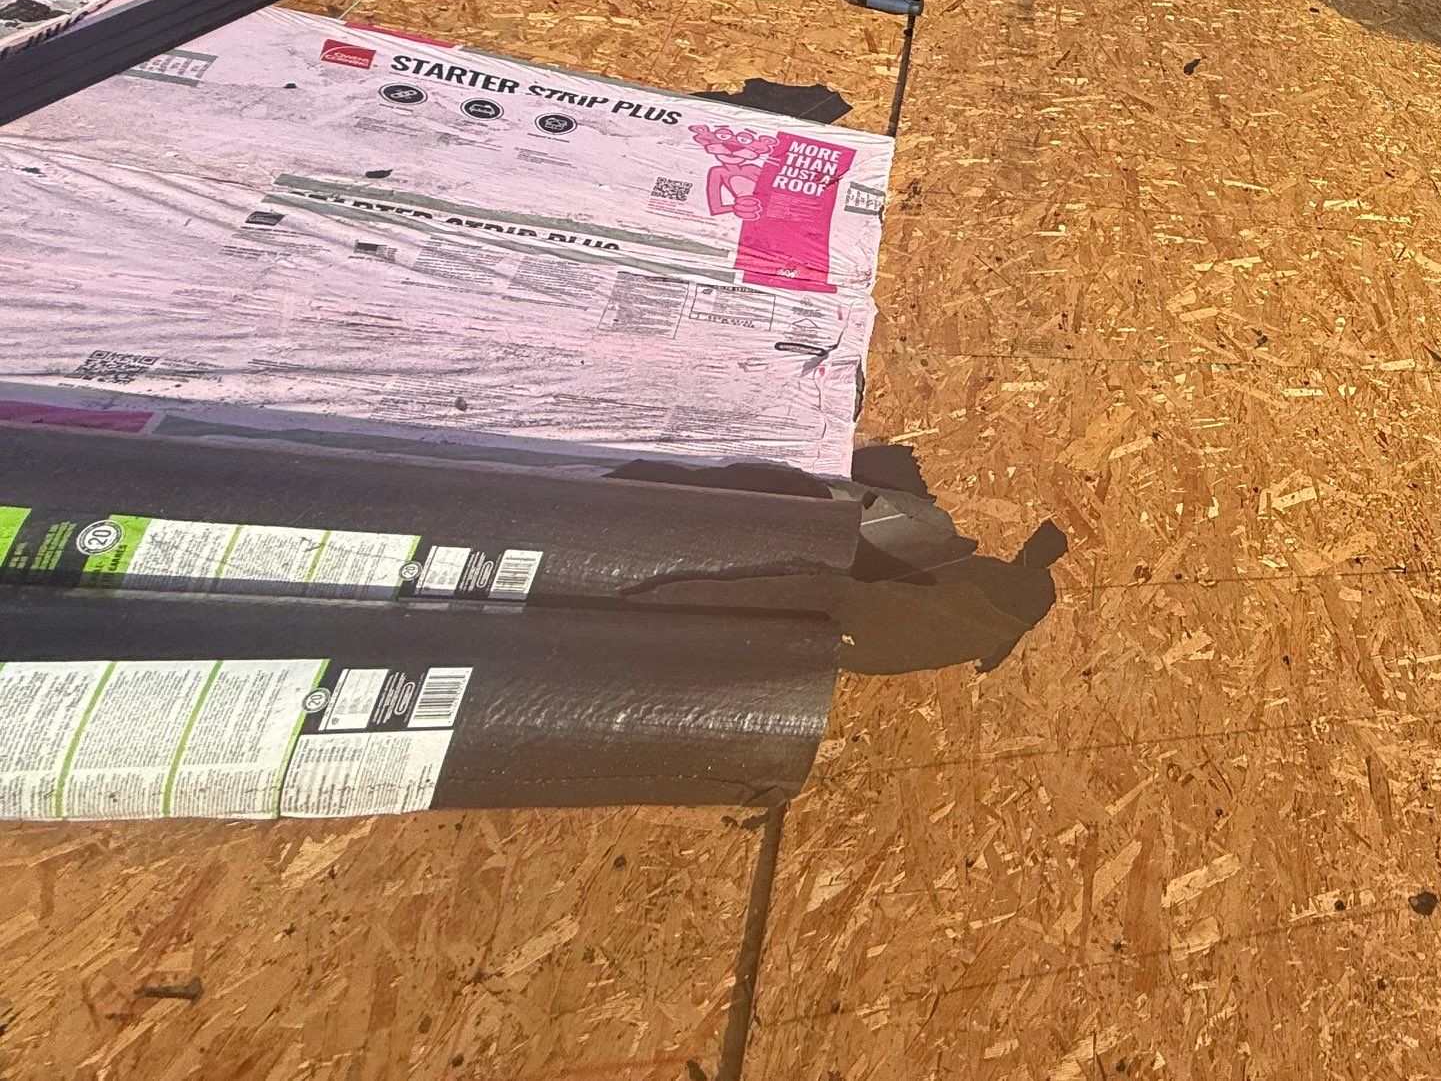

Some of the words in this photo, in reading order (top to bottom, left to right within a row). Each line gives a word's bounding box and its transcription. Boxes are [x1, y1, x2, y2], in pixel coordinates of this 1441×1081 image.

[390, 54, 520, 95] STARTER
[525, 84, 609, 109] STRIP
[610, 100, 683, 126] PLUS
[789, 141, 842, 163] MORE
[784, 152, 838, 176] THAN
[778, 166, 816, 183] JUST
[820, 174, 832, 185] A
[771, 176, 828, 197] ROOF
[88, 529, 112, 546] 20
[307, 694, 323, 706] 20
